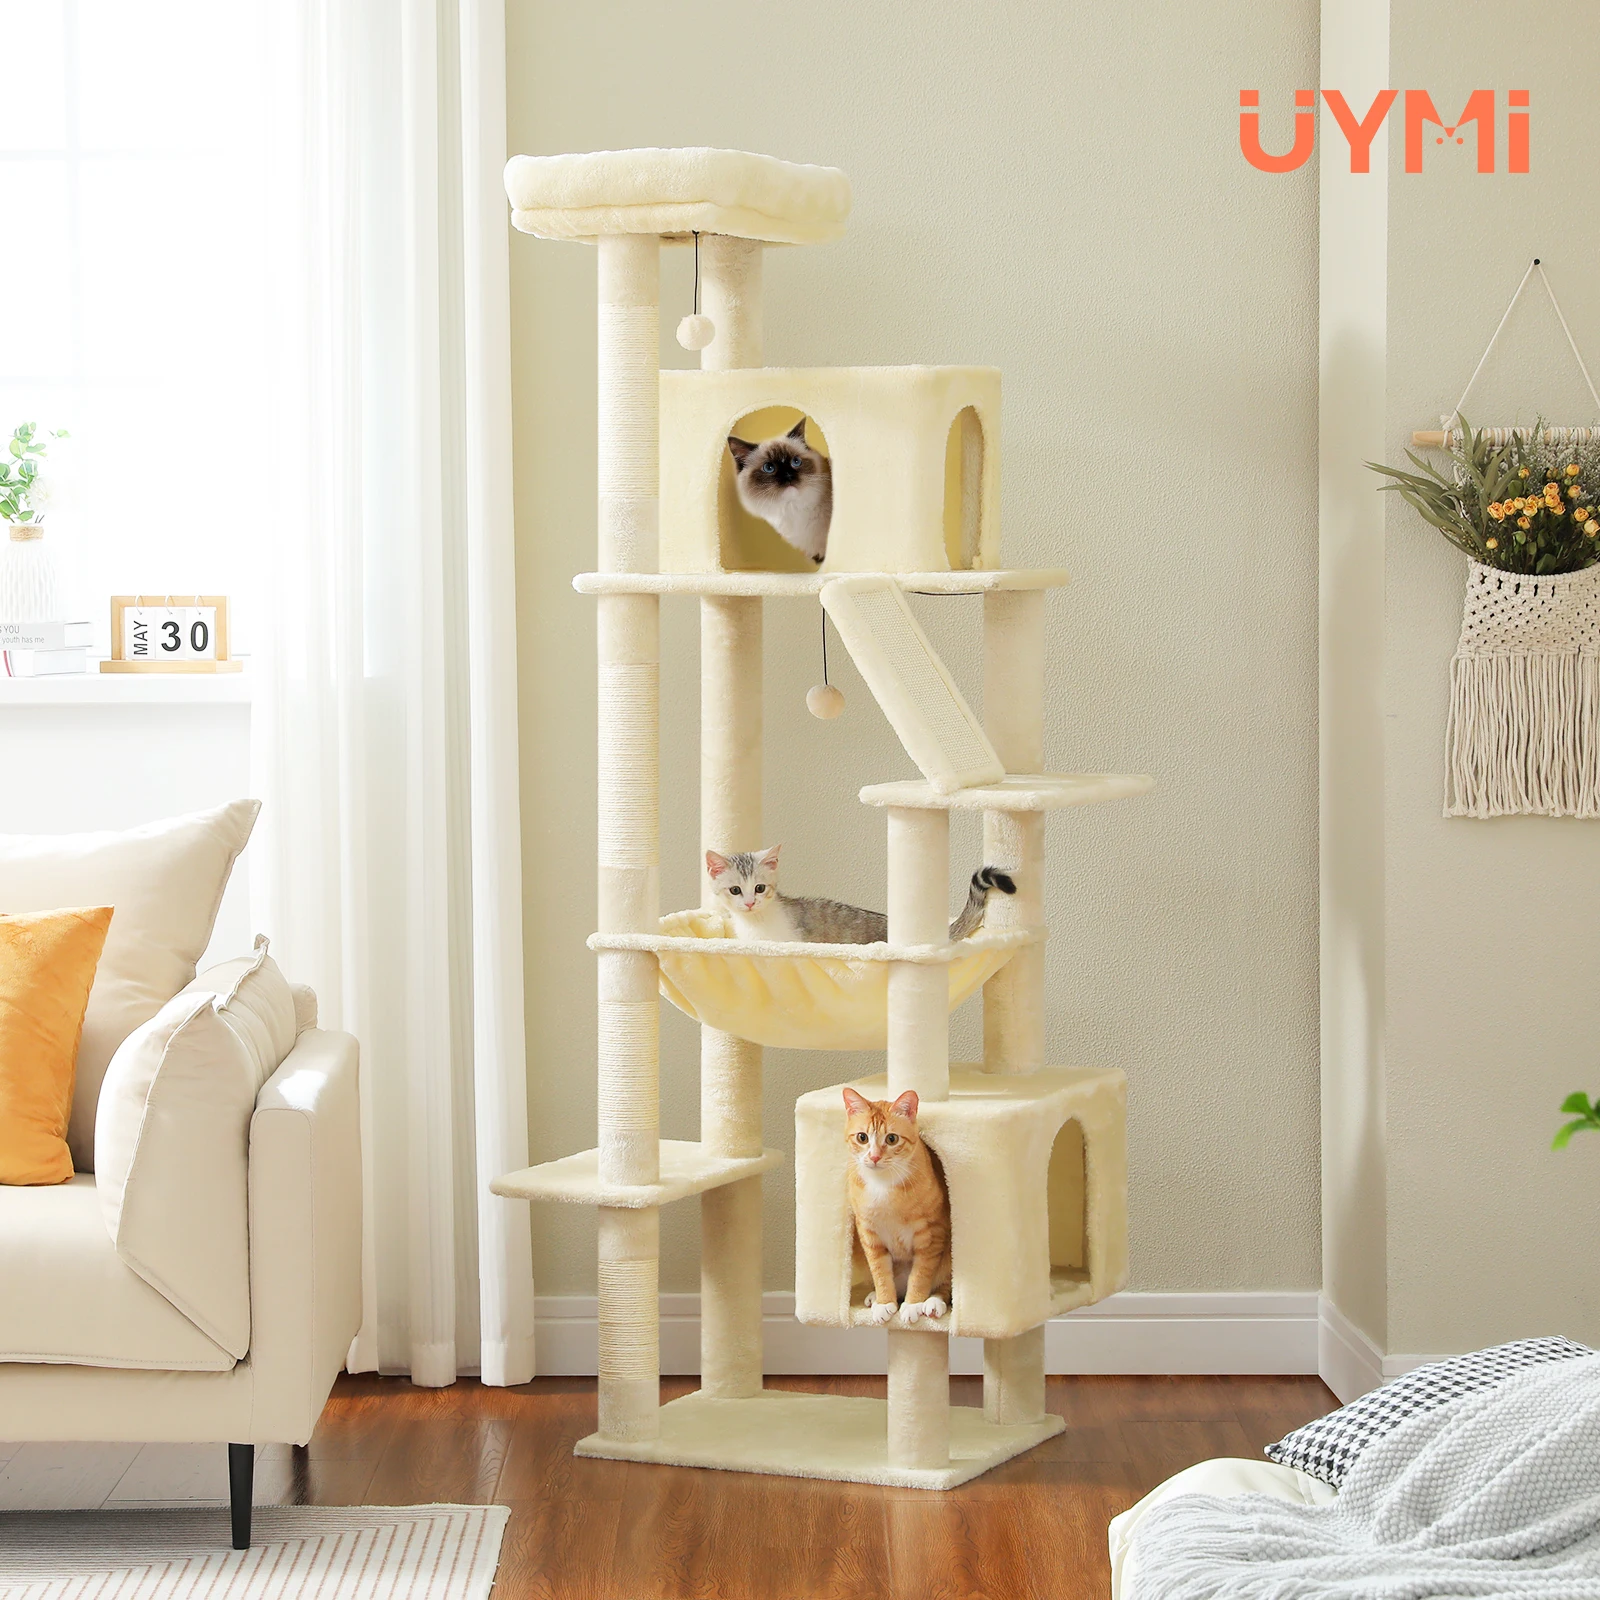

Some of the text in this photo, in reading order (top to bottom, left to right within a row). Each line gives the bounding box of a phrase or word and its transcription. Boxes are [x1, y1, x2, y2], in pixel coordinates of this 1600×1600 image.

[4, 625, 20, 634] YOU
[2, 636, 20, 644] youth
[133, 620, 209, 655] MAY 30
